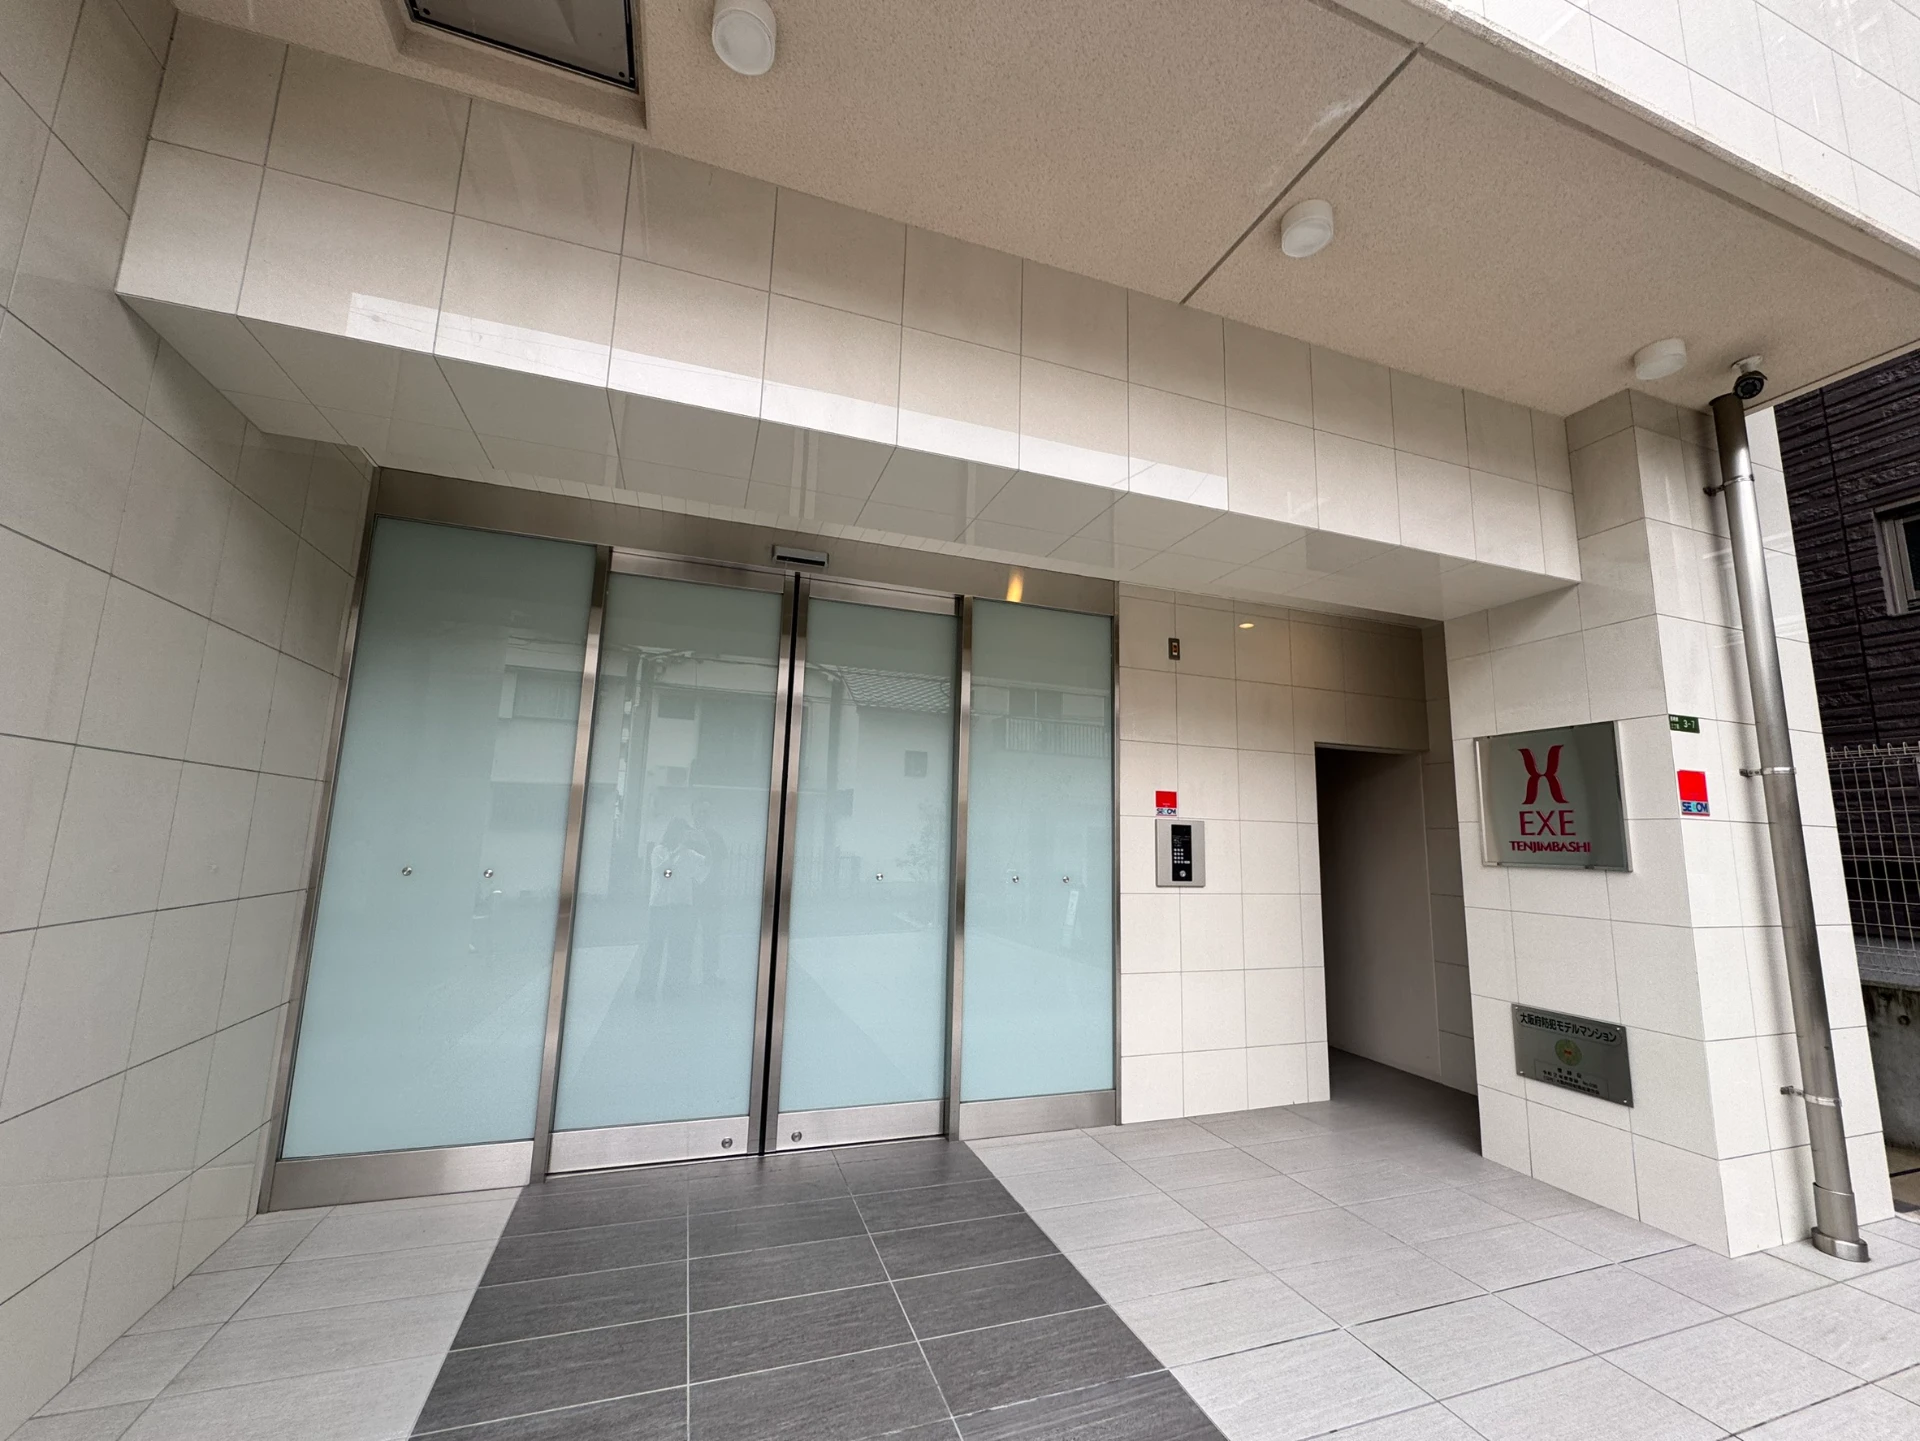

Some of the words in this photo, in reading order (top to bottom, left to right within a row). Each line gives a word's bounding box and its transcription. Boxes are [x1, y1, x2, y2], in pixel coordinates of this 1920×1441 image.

[1683, 719, 1695, 729] 3-7
[1682, 801, 1709, 813] SECOM
[1519, 810, 1576, 836] EXE
[1509, 841, 1591, 853] TENJIMBASHI
[1520, 1013, 1617, 1042] 大阪府防犯モデルマンション
